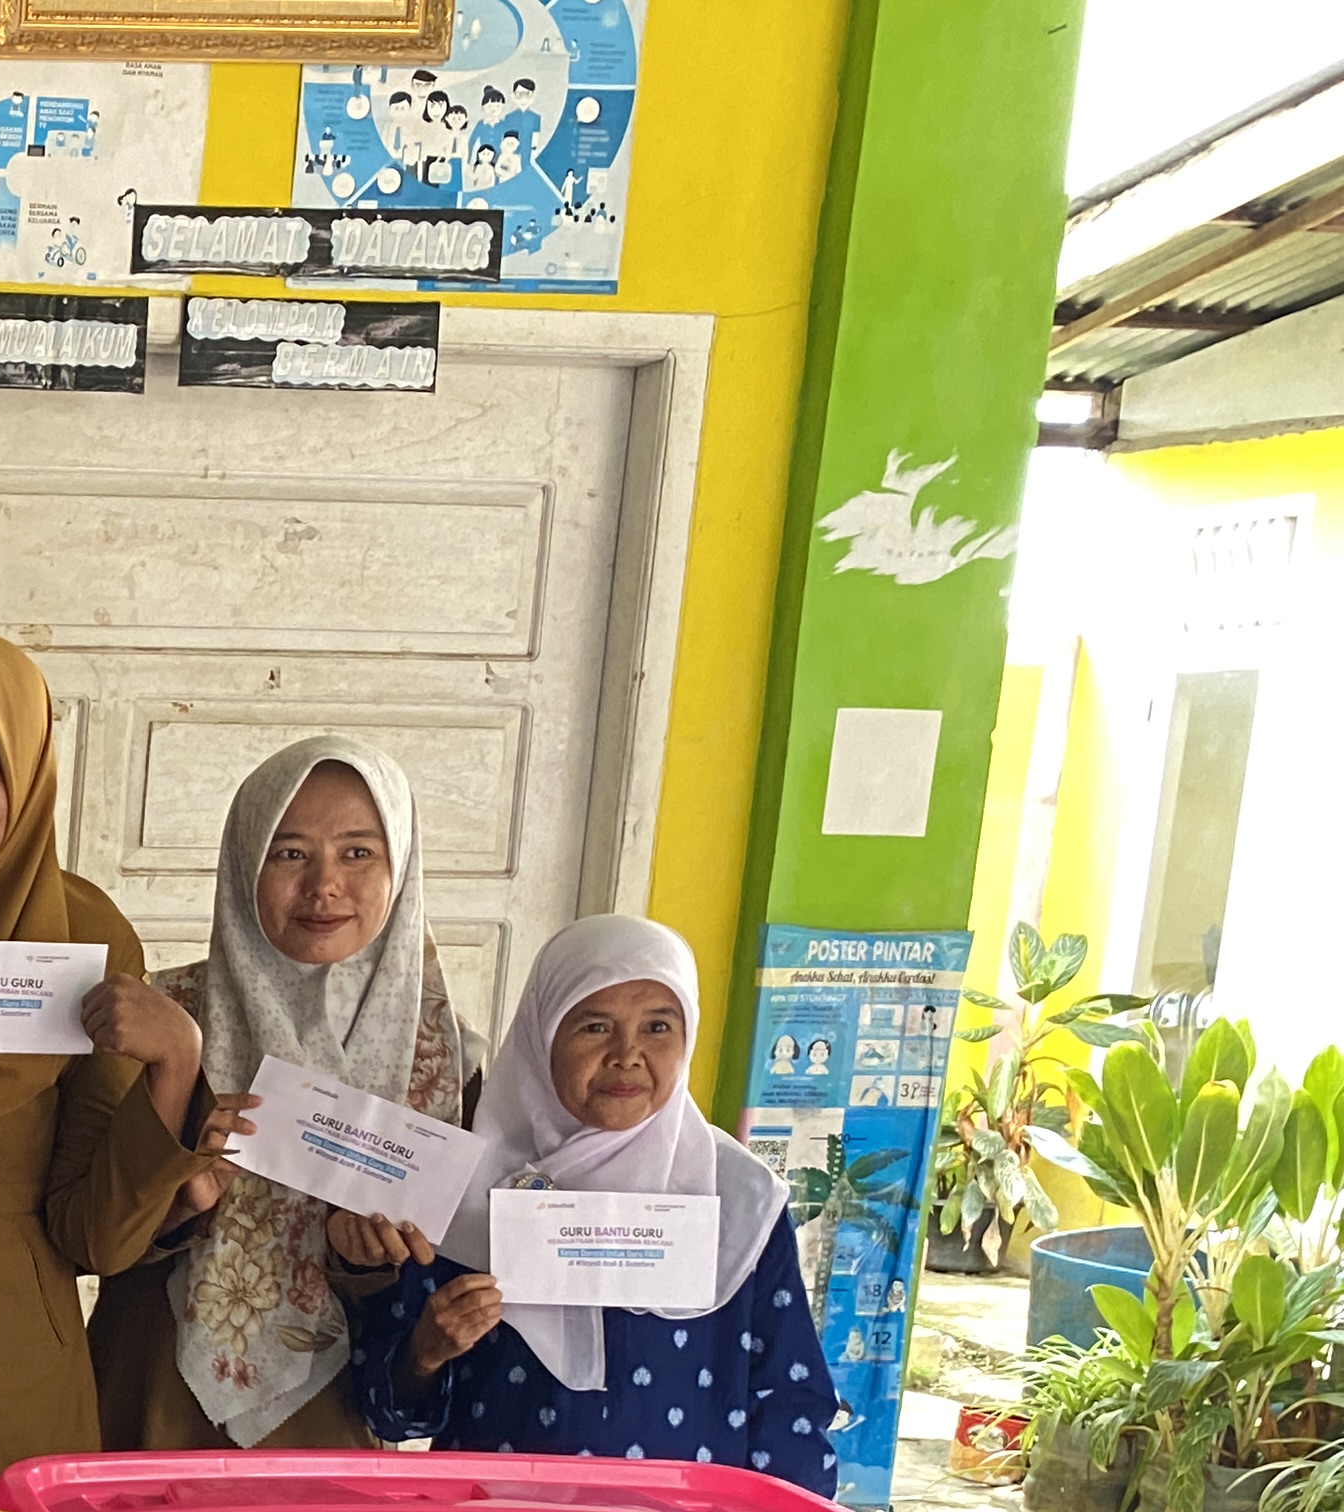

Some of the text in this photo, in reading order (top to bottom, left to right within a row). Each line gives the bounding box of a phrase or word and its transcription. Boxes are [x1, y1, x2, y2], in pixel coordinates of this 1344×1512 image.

[146, 221, 485, 266] SELAMAT DATANG
[191, 301, 341, 339] KELOMPOK
[277, 345, 430, 382] BERMAIN
[808, 940, 935, 962] POSTER PINTAR
[11, 978, 43, 988] GURU
[312, 1113, 414, 1159] GURU BANTU GURU
[560, 1227, 663, 1238] GURU BANTU GURU
